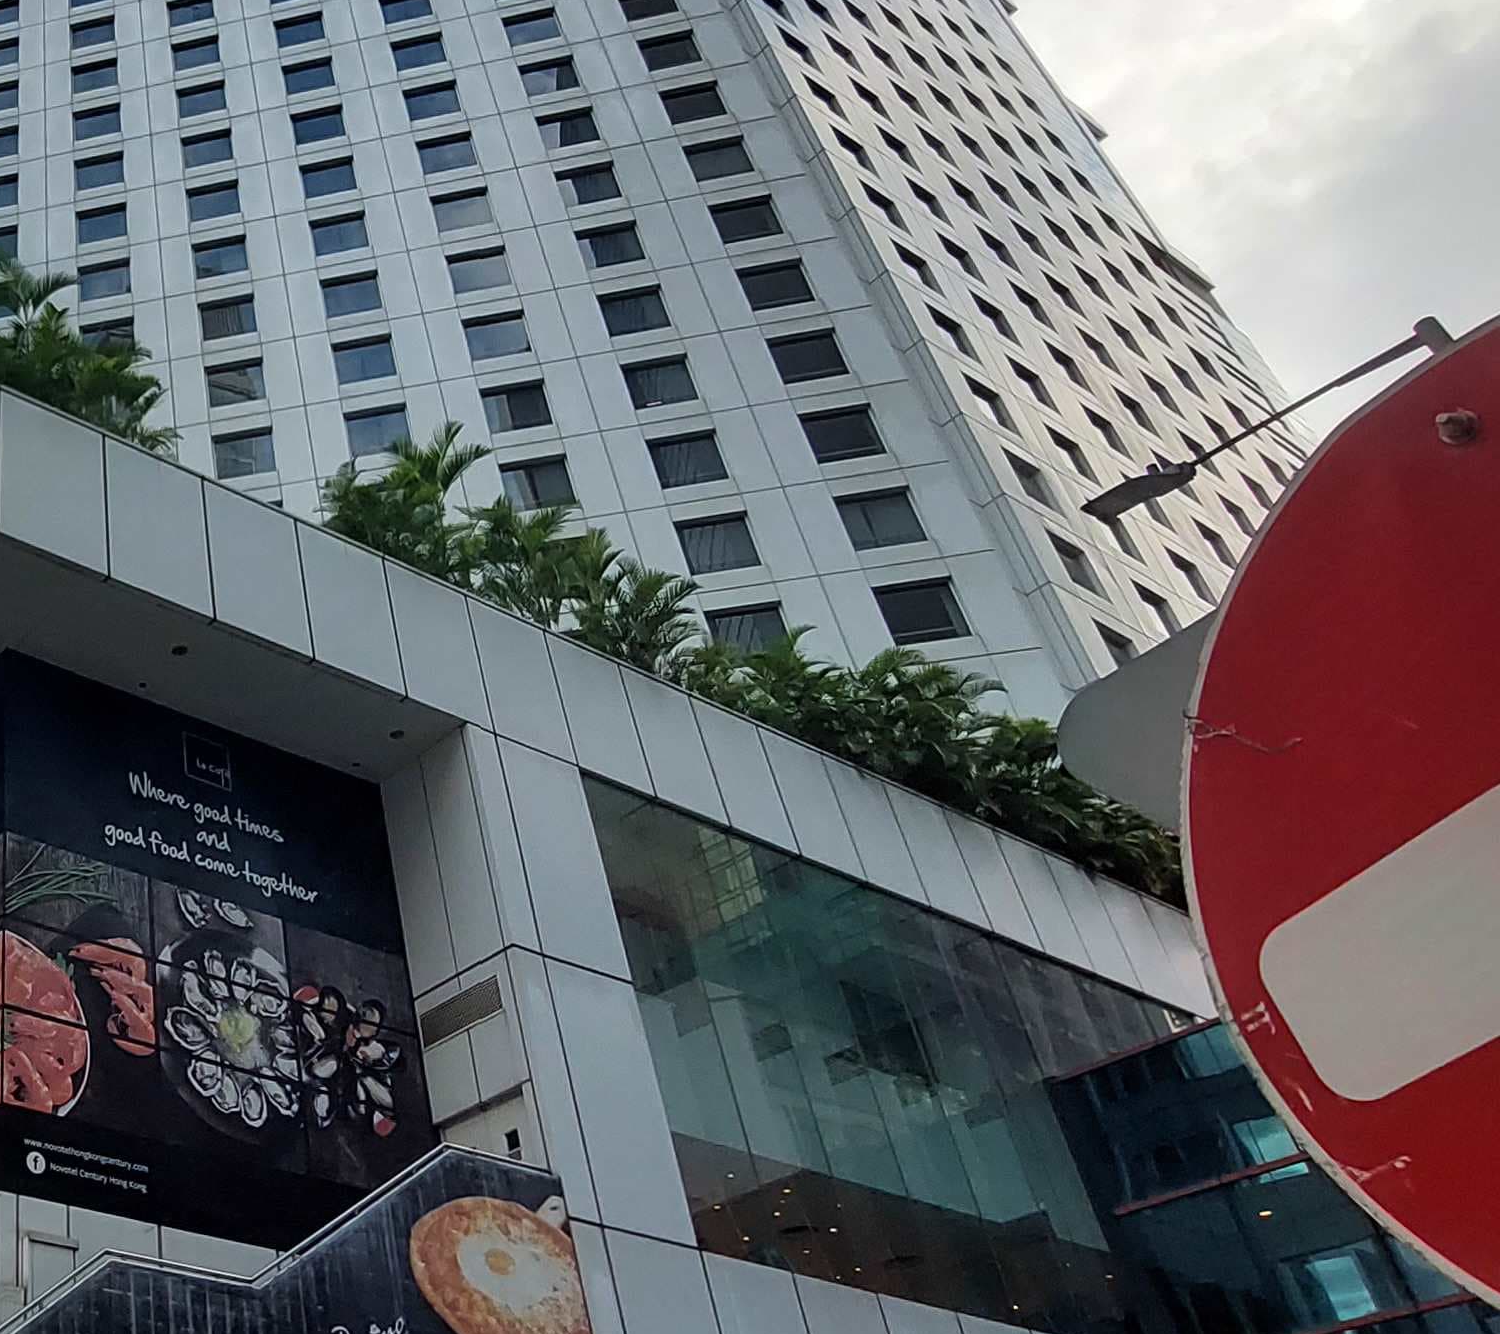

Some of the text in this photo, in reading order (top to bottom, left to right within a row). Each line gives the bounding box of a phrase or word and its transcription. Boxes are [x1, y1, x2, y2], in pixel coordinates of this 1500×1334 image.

[129, 771, 284, 843] Where good times
[196, 830, 231, 853] and
[104, 824, 318, 903] good food come together
